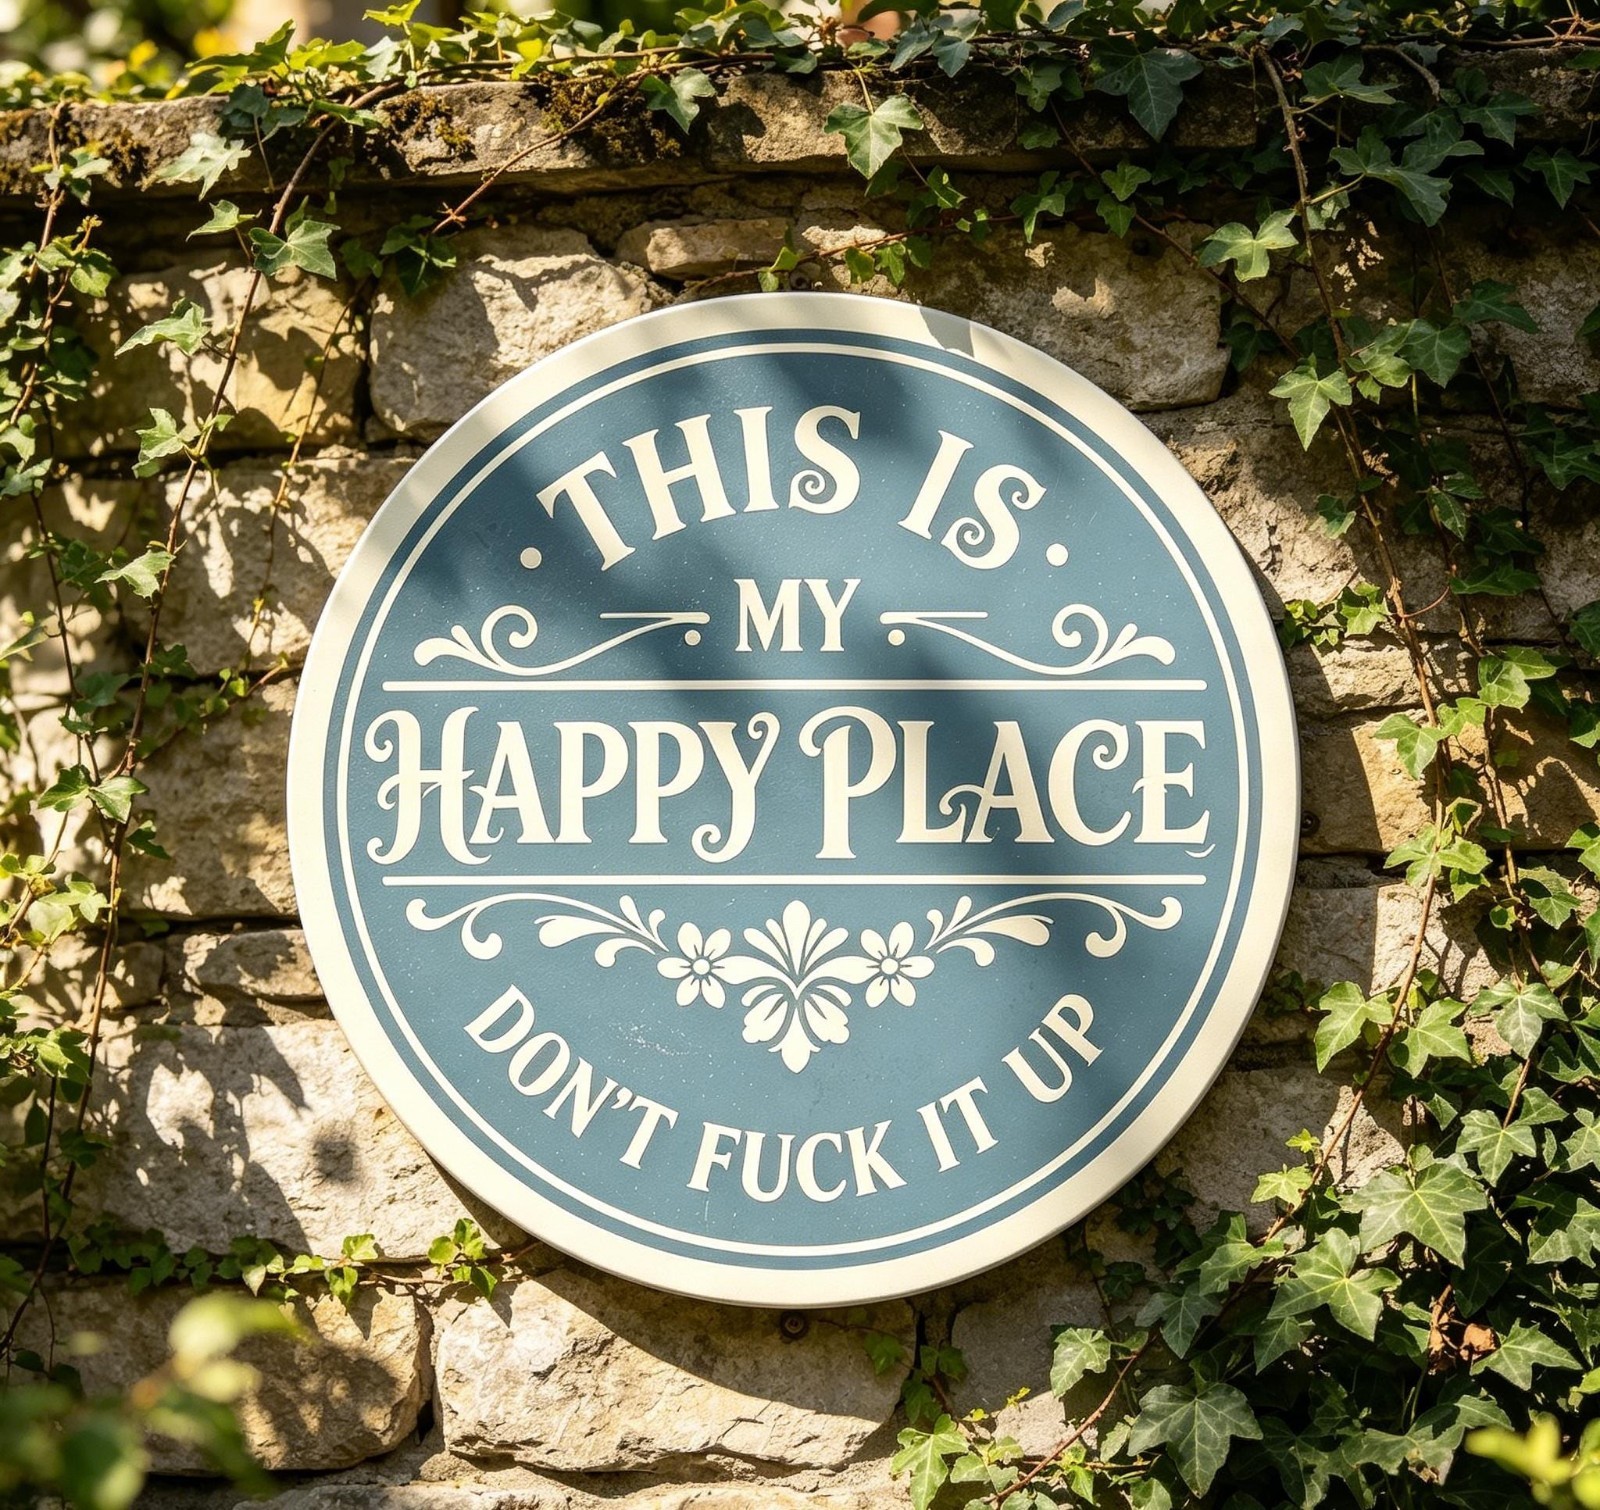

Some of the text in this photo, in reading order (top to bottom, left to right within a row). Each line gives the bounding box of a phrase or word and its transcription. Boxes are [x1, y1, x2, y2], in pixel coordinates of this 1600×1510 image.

[537, 405, 1046, 571] THIS IS
[735, 578, 860, 653] MY
[364, 706, 1214, 864] HAPPY PLACE
[464, 985, 1104, 1203] DON'T FUCK IT UP
